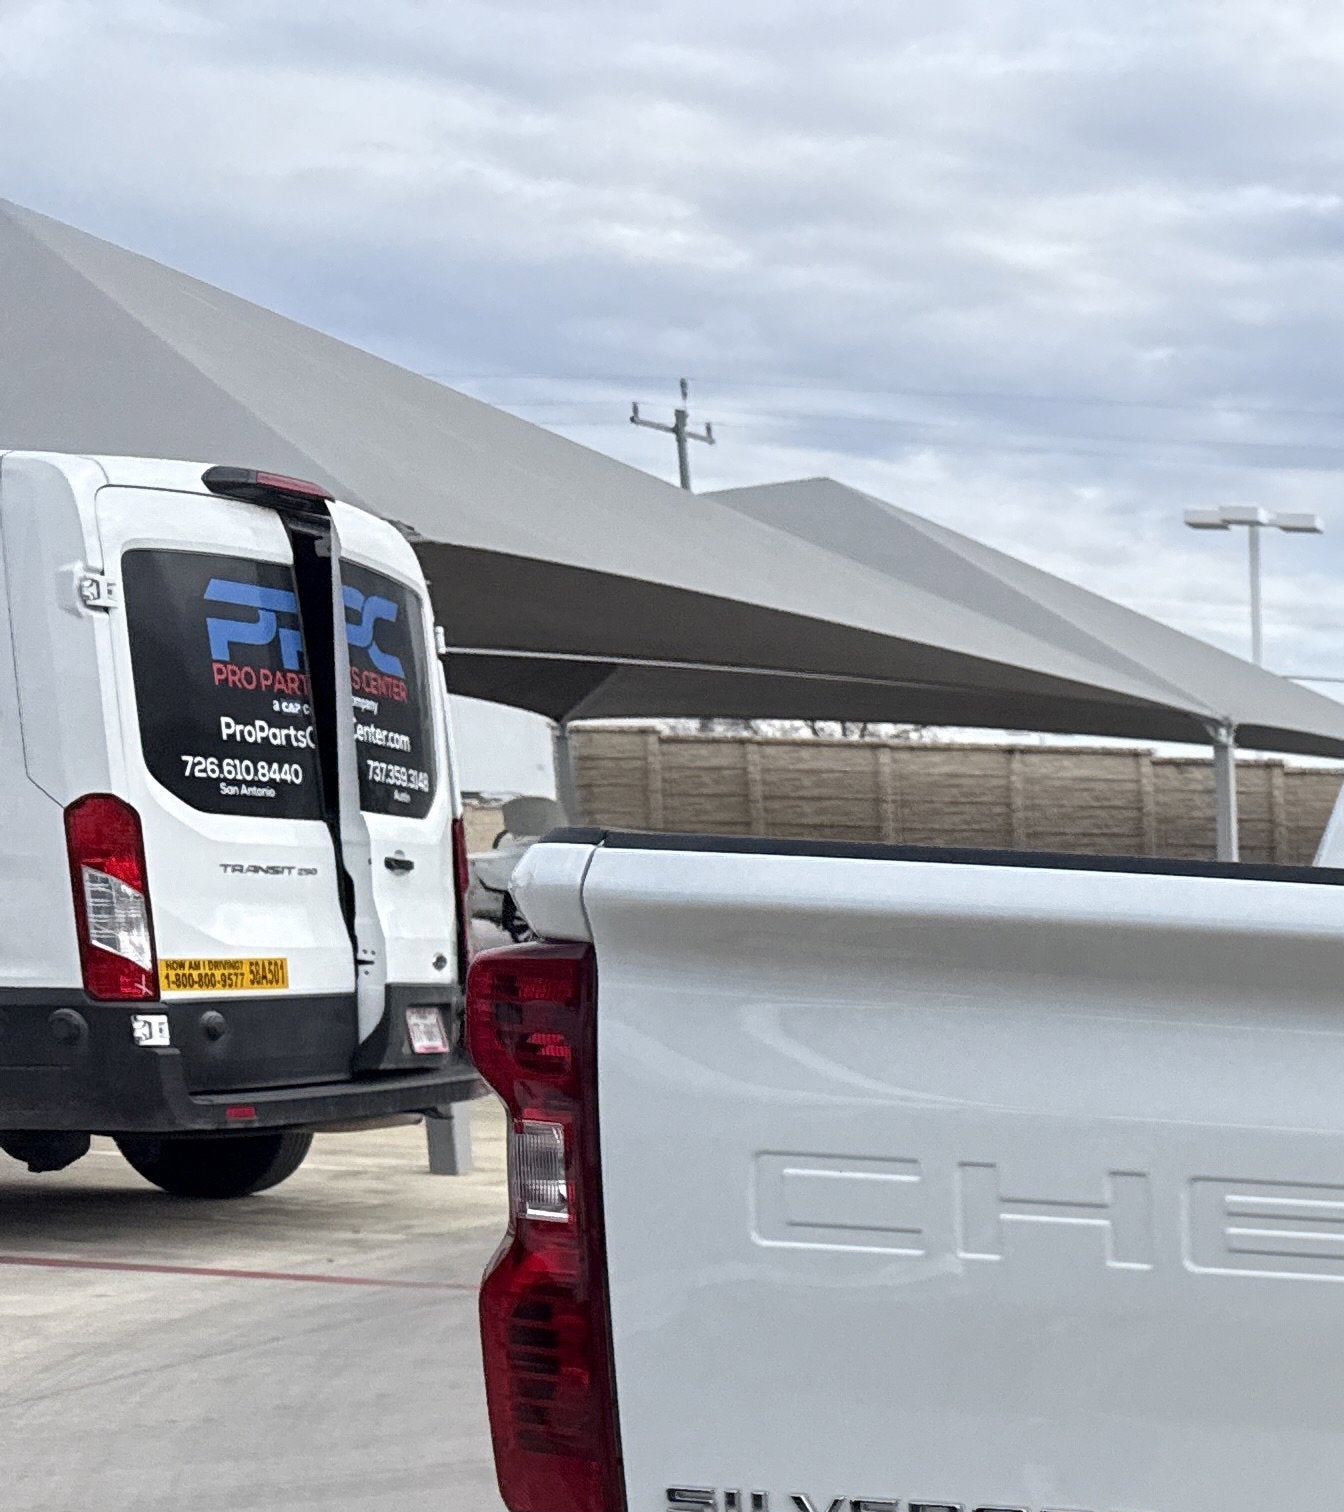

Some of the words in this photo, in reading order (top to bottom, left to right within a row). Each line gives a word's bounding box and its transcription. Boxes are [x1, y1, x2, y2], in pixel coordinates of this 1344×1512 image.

[212, 662, 257, 690] PRO
[180, 755, 303, 785] 726.610.8440
[219, 782, 239, 796] San
[240, 783, 276, 798] Antonio
[219, 863, 296, 876] TRANSIT
[165, 959, 186, 971] HOW
[188, 959, 202, 971] AM
[164, 972, 245, 989] 1-800-800-9577
